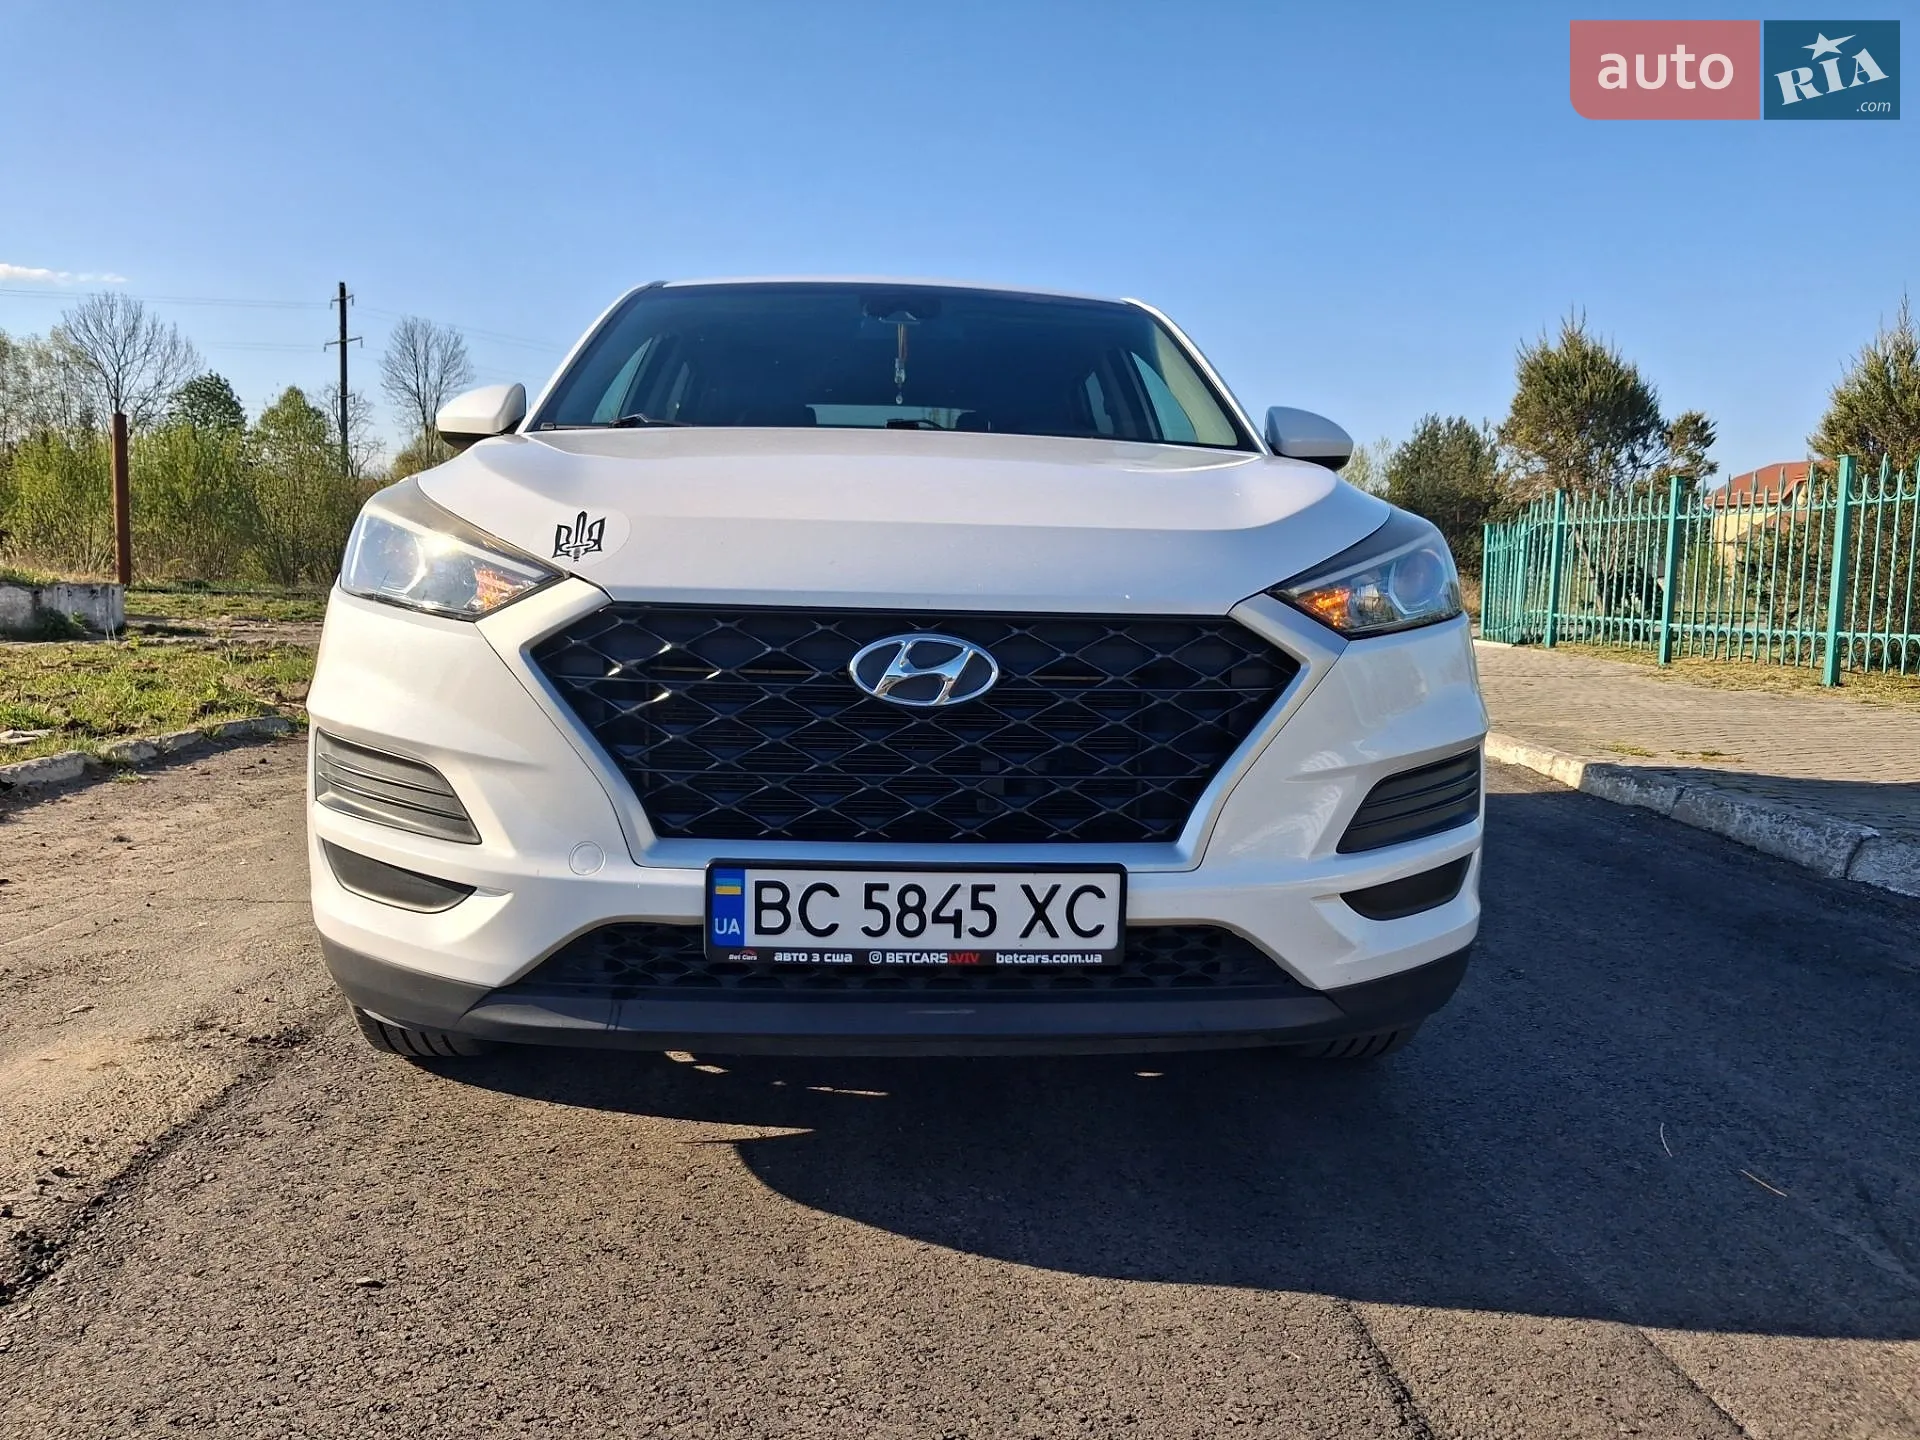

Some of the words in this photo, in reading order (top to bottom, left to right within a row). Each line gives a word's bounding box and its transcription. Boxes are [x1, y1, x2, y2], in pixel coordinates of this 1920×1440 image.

[753, 879, 841, 938] BC
[861, 882, 998, 939] 5845
[1019, 883, 1107, 939] XC
[714, 917, 741, 935] UA
[995, 952, 1103, 964] betcars.com.ua
